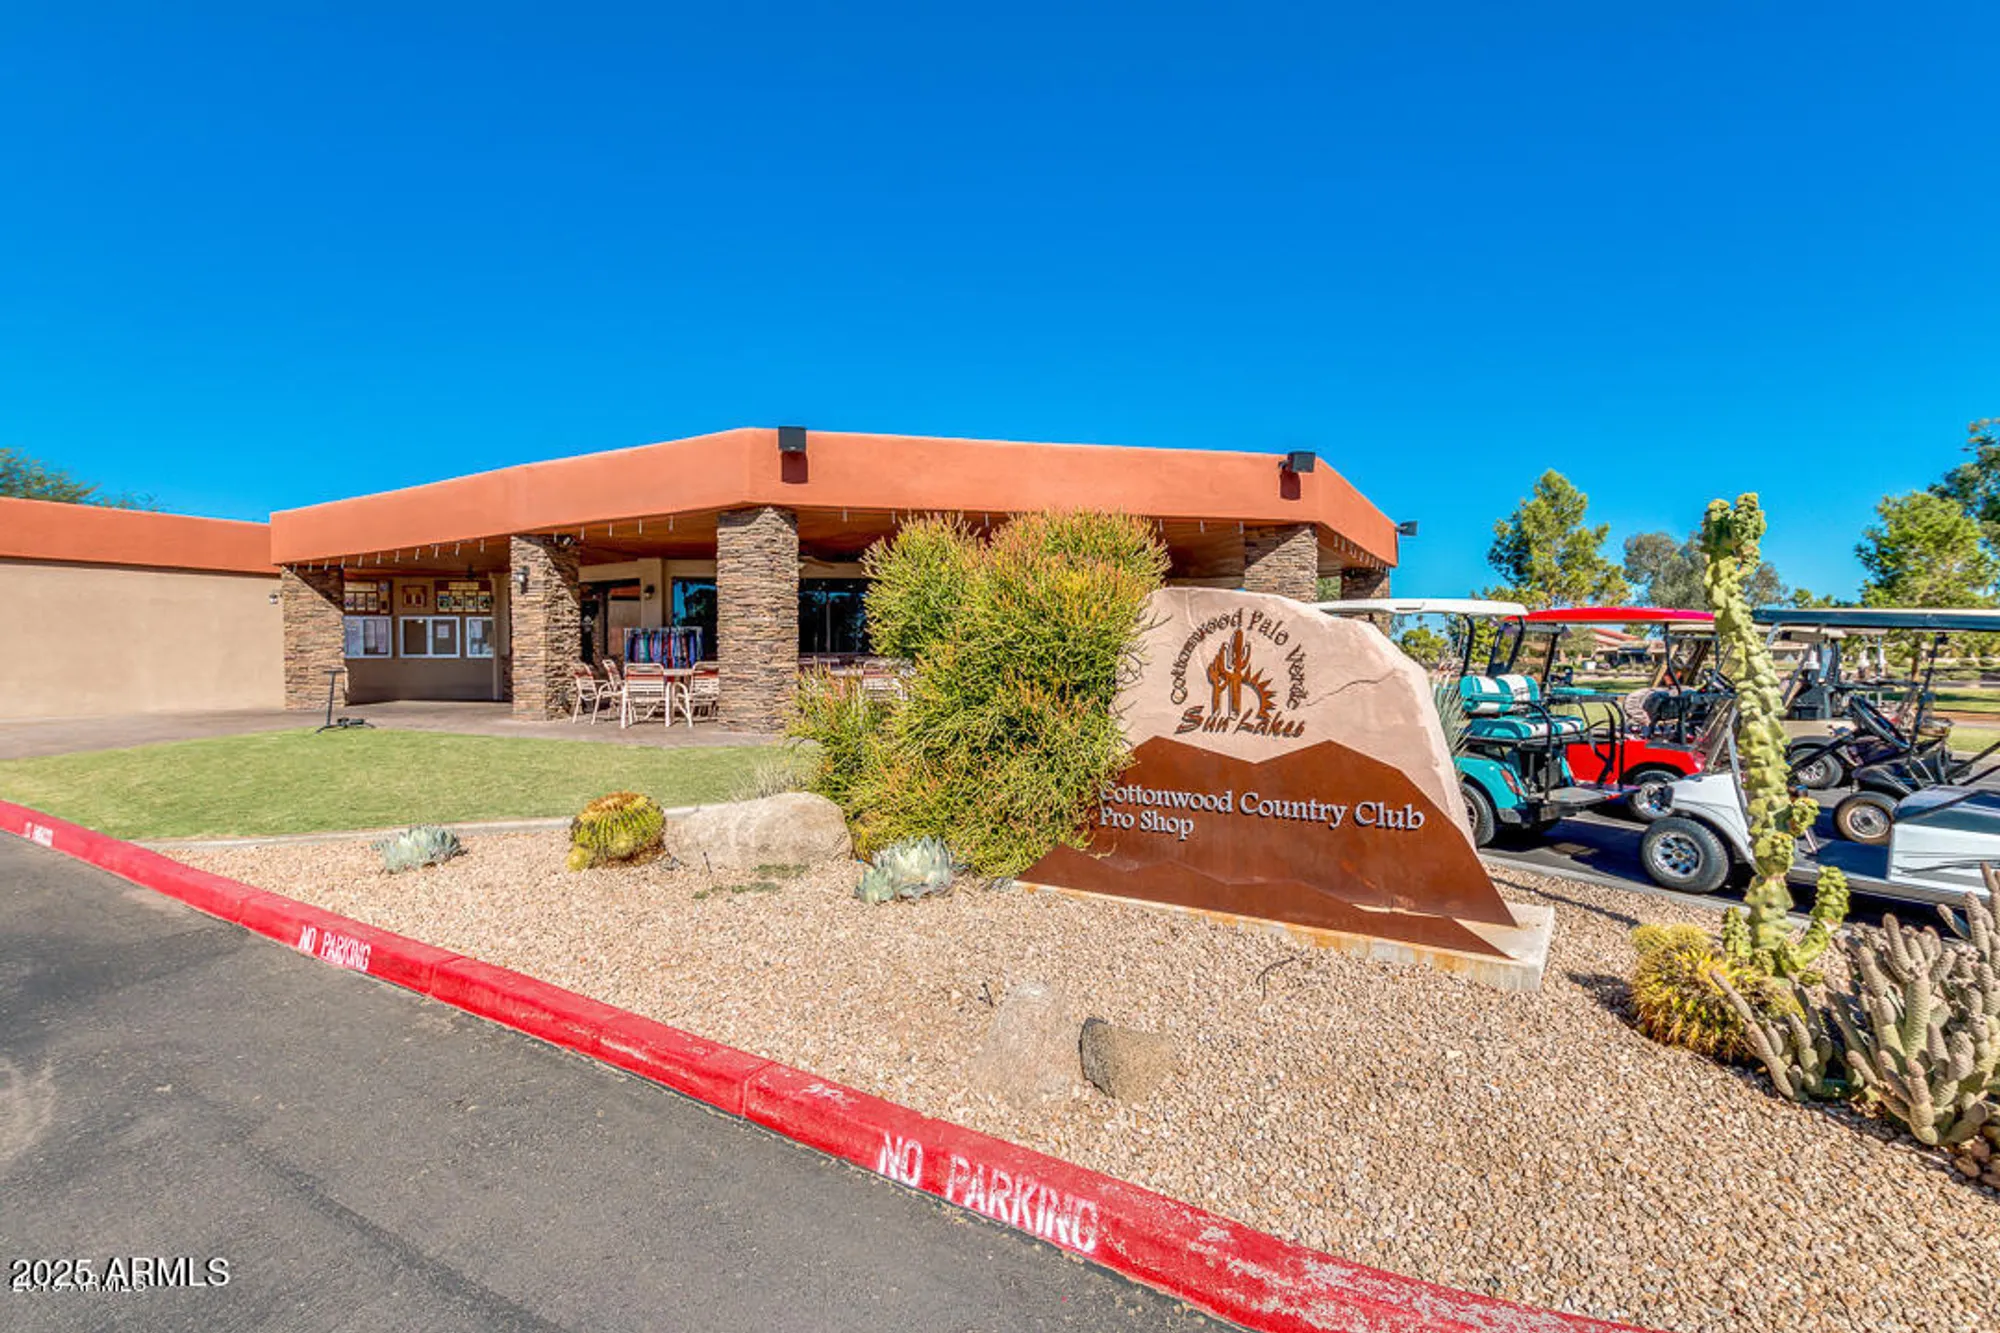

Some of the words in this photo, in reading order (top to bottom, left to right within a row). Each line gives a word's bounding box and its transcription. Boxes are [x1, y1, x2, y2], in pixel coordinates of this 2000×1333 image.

[1170, 607, 1243, 705] Cottonwood
[1247, 610, 1289, 646] Palo
[1285, 643, 1309, 710] Verde
[1174, 705, 1230, 734] Sun
[1233, 708, 1305, 738] Lakes
[1099, 806, 1135, 829] Pro
[1140, 809, 1194, 841] Shop
[1100, 780, 1233, 813] Cottonwood
[1240, 792, 1347, 829] Country
[1354, 801, 1425, 830] Club
[298, 924, 317, 953] NO
[321, 931, 371, 972] PARKING
[877, 1131, 924, 1188] NO
[945, 1154, 1098, 1253] PARKING
